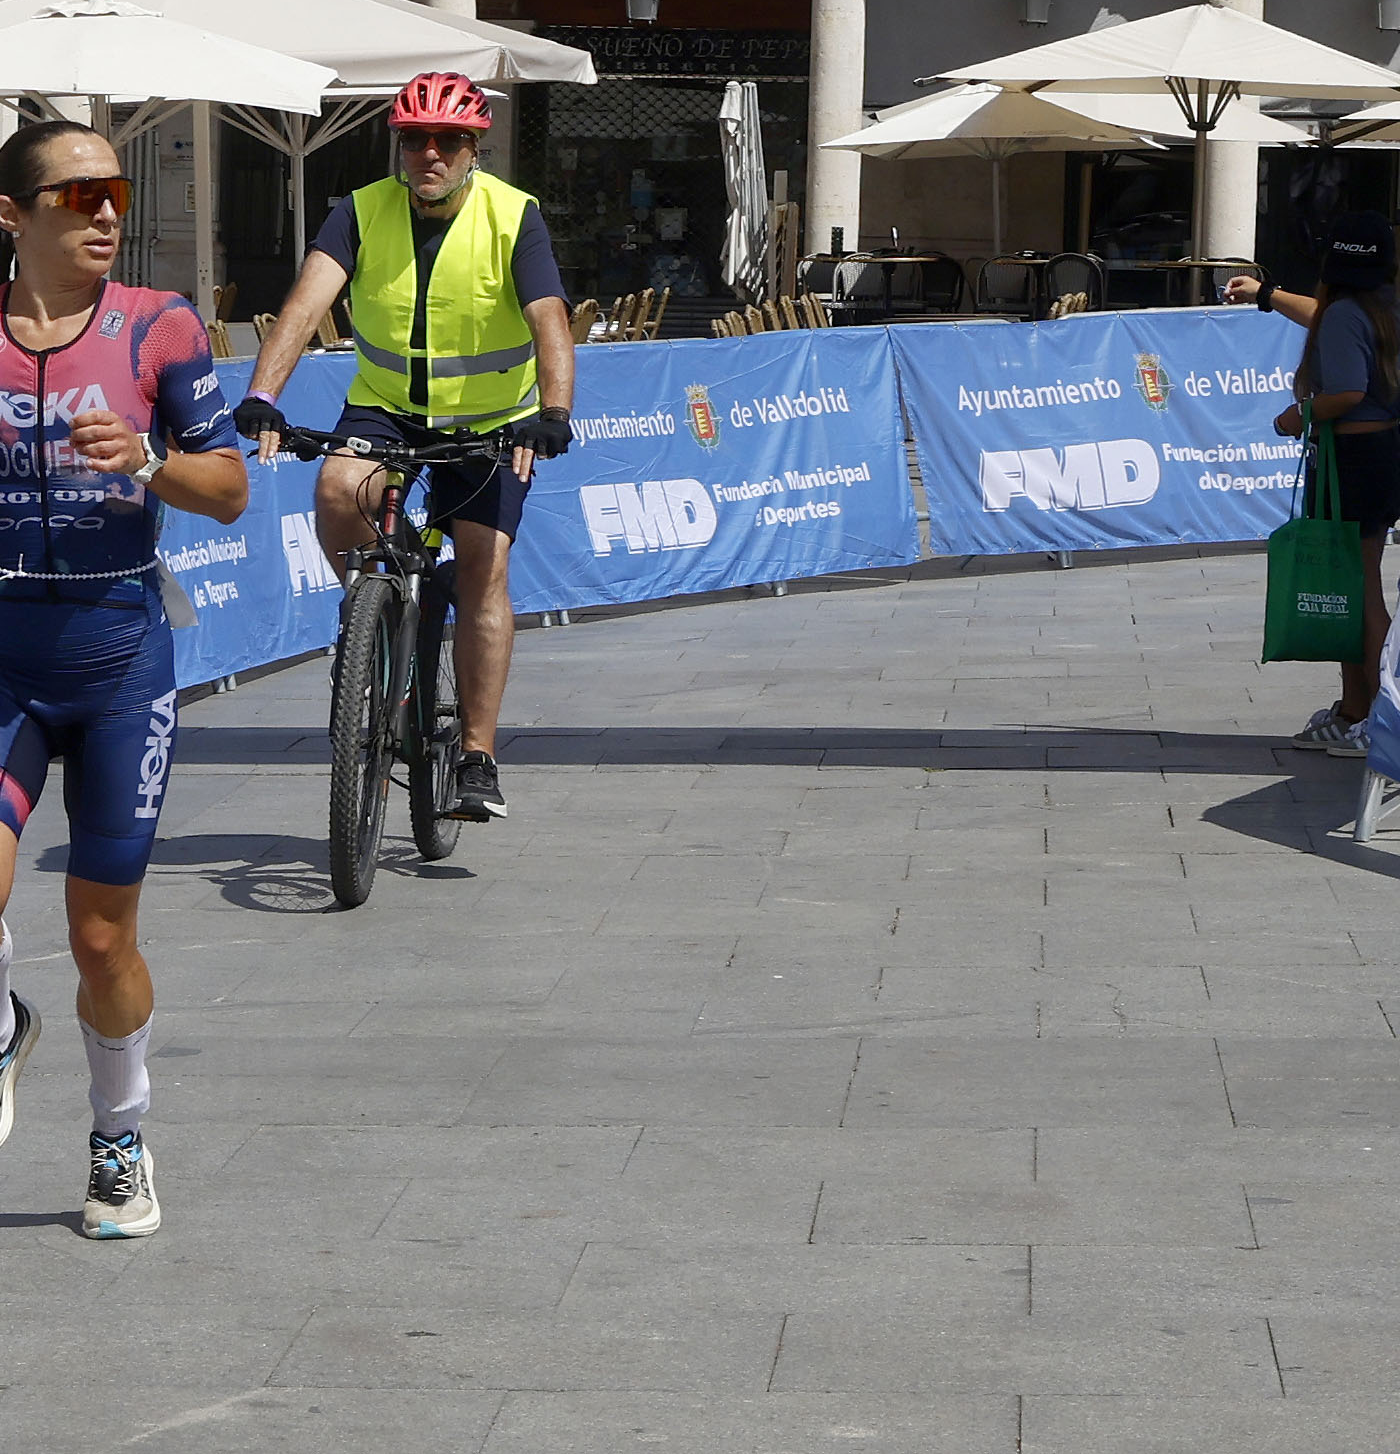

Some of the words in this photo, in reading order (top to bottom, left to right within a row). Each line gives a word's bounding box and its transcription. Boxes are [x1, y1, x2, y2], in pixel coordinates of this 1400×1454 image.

[1332, 241, 1378, 254] ENOLA
[730, 401, 754, 429] de
[754, 387, 851, 425] Valldolid
[958, 376, 1121, 416] Ayuntamiento
[1185, 372, 1211, 397] de
[784, 462, 871, 491] Municipal
[979, 439, 1161, 513] FMD
[579, 478, 718, 557] FMD
[165, 540, 209, 574] Fundació
[135, 689, 177, 820] HOKA
